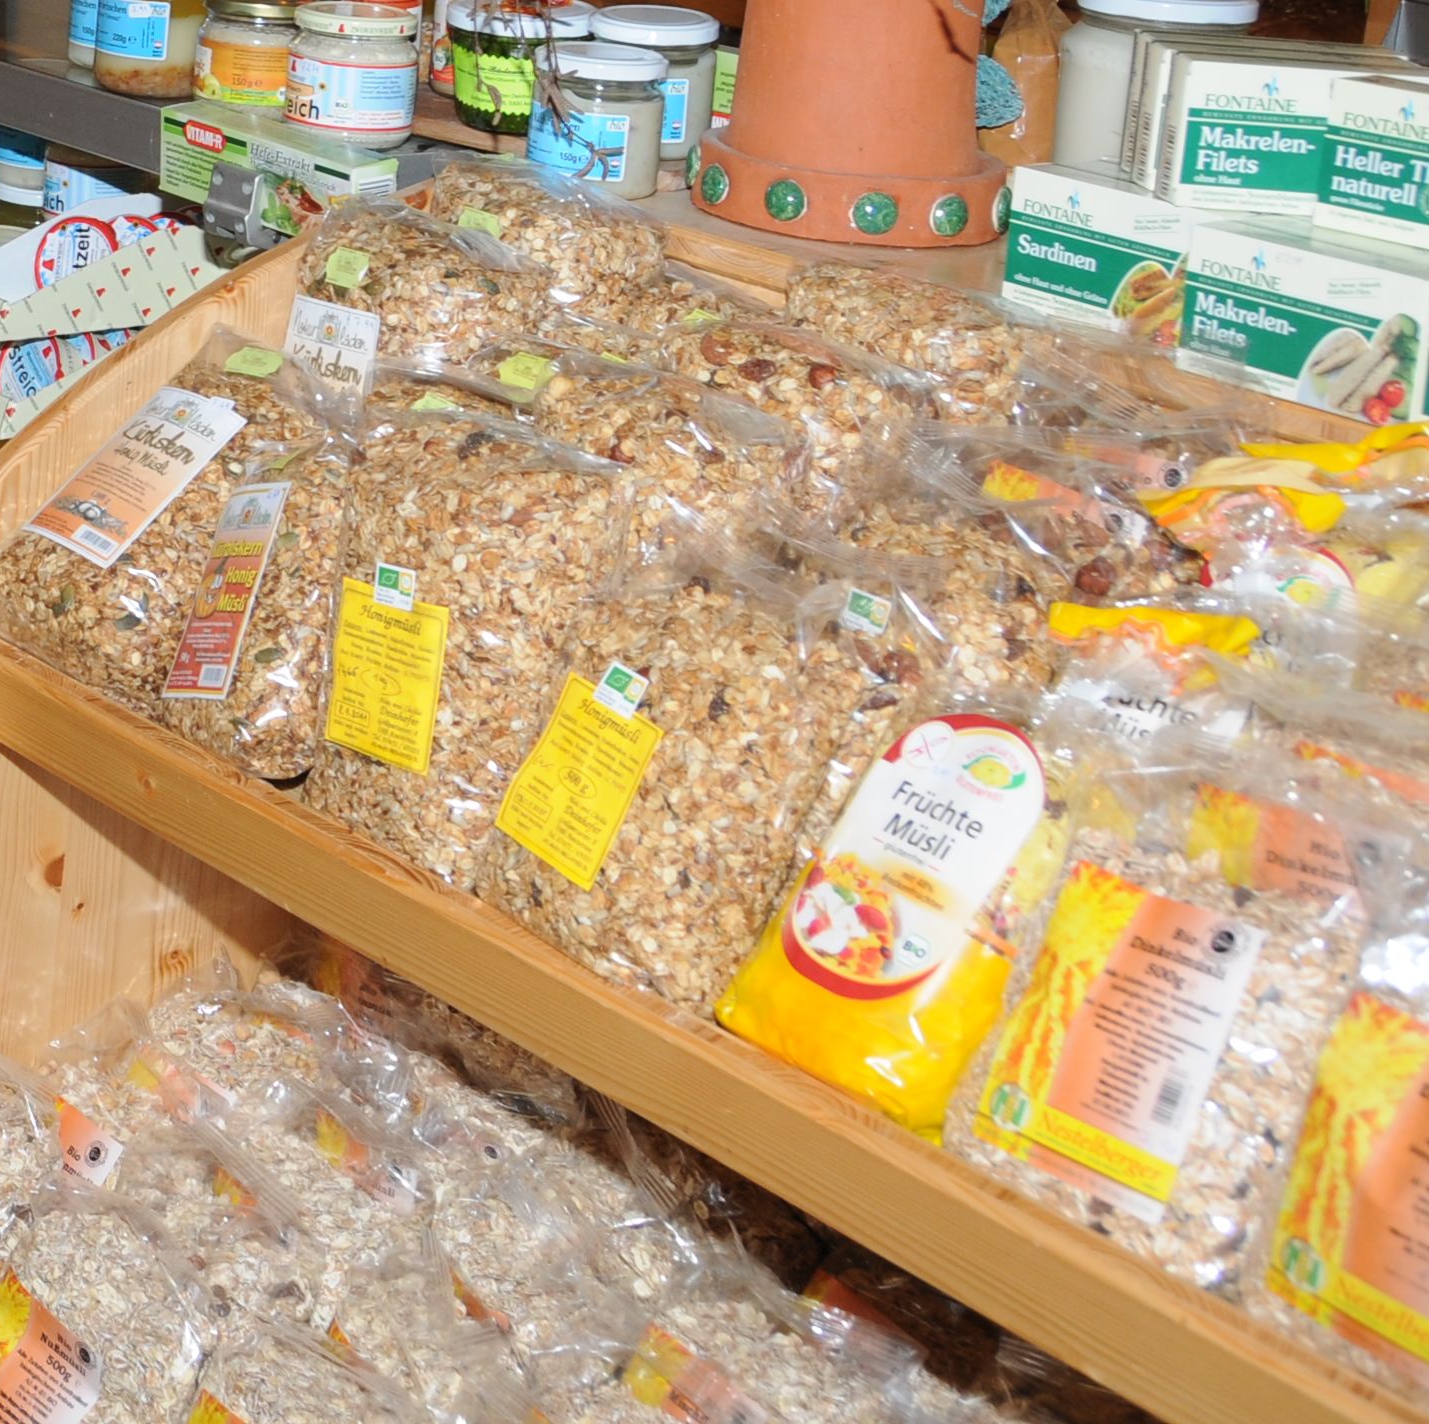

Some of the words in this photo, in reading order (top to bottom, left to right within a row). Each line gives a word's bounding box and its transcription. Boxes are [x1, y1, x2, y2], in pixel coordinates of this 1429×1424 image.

[287, 99, 320, 120] eich
[1204, 93, 1298, 114] FONTAINE
[1198, 126, 1316, 154] Makrelen-
[250, 143, 312, 173] Hefe-Extrakt
[1196, 149, 1259, 174] Filets
[1334, 145, 1404, 177] Heller
[1331, 176, 1418, 206] naturell
[1024, 198, 1093, 227] FONTAINE
[73, 226, 90, 269] tzeit
[1017, 233, 1097, 272] Sardinen
[1201, 259, 1281, 292] FONTAINE
[1195, 292, 1297, 336] Makrelen-
[1191, 315, 1247, 347] Filets
[9, 345, 37, 397] Streic
[225, 567, 257, 588] Honig
[216, 592, 249, 614] Müsli
[359, 604, 422, 637] Honigmüsli
[579, 699, 641, 744] Honigmüsli
[891, 780, 983, 840] Früchte
[883, 813, 956, 861] Müsli
[1130, 937, 1226, 979] Dinkelmüsli
[66, 1145, 81, 1163] Bio
[1043, 1111, 1162, 1183] Nestelberger
[57, 1332, 73, 1352] Bio
[46, 1354, 72, 1384] 500g
